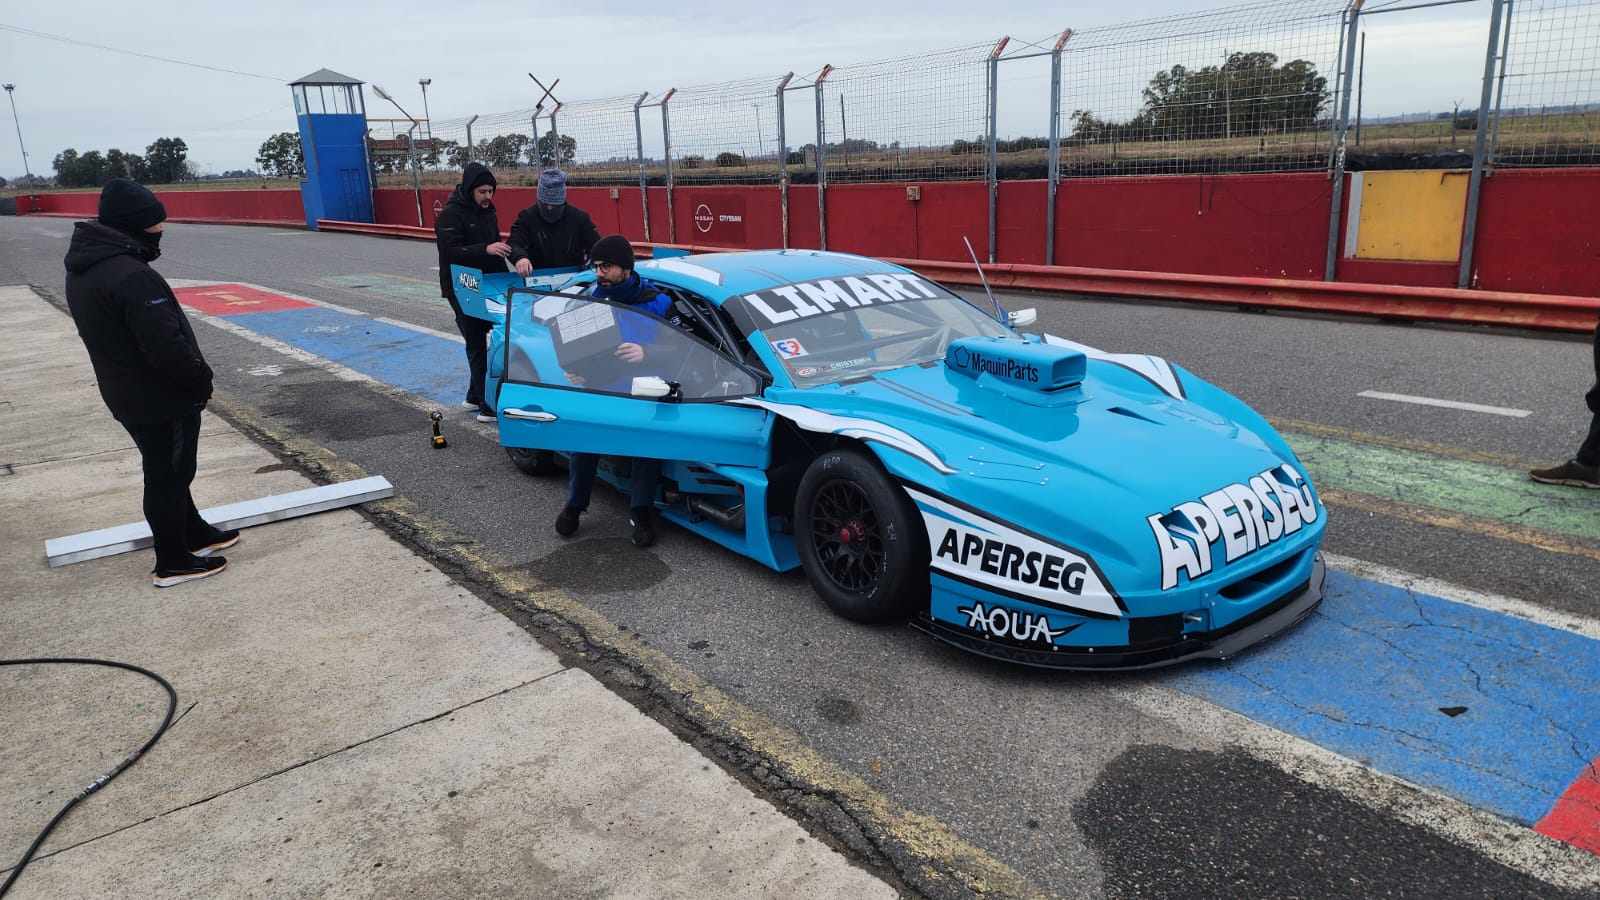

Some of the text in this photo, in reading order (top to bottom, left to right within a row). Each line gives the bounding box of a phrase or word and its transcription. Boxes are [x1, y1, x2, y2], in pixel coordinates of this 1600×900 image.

[743, 273, 938, 325] LIMART
[971, 351, 1039, 383] MaquinParts
[1146, 463, 1318, 592] APERSEG
[936, 527, 1088, 596] APERSEG
[960, 602, 1066, 644] AQUA
